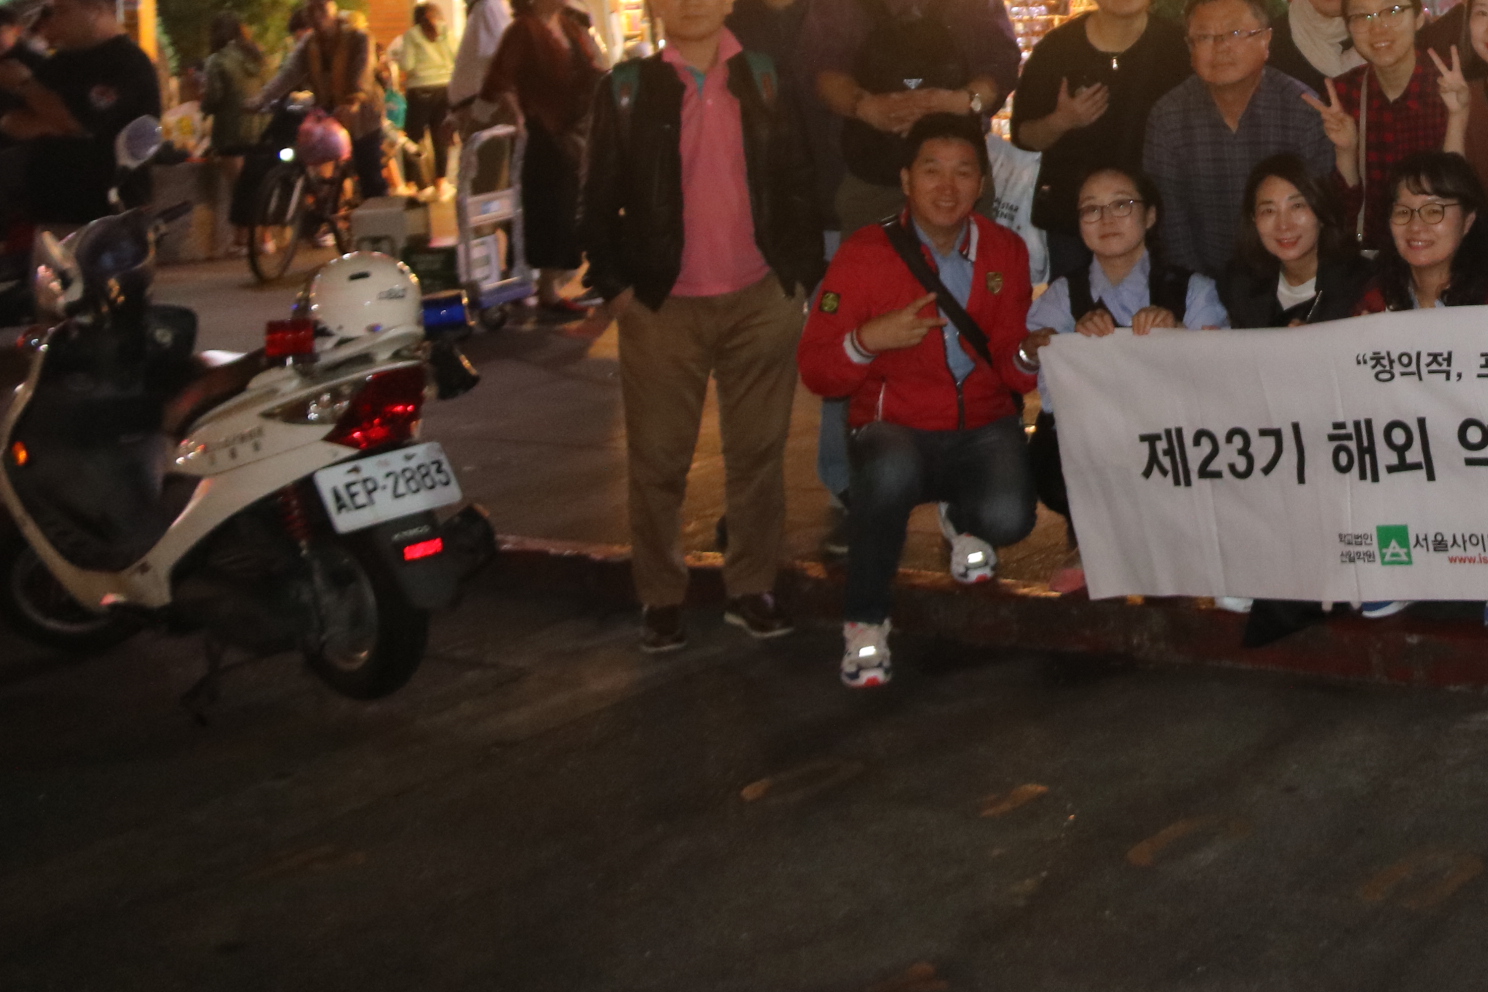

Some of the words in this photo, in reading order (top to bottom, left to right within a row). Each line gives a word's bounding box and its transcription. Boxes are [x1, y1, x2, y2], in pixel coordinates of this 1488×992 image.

[1354, 349, 1463, 383] “창의적,
[1138, 421, 1306, 488] 제23기
[1327, 416, 1436, 484] 해외
[330, 460, 452, 516] AEP-2883
